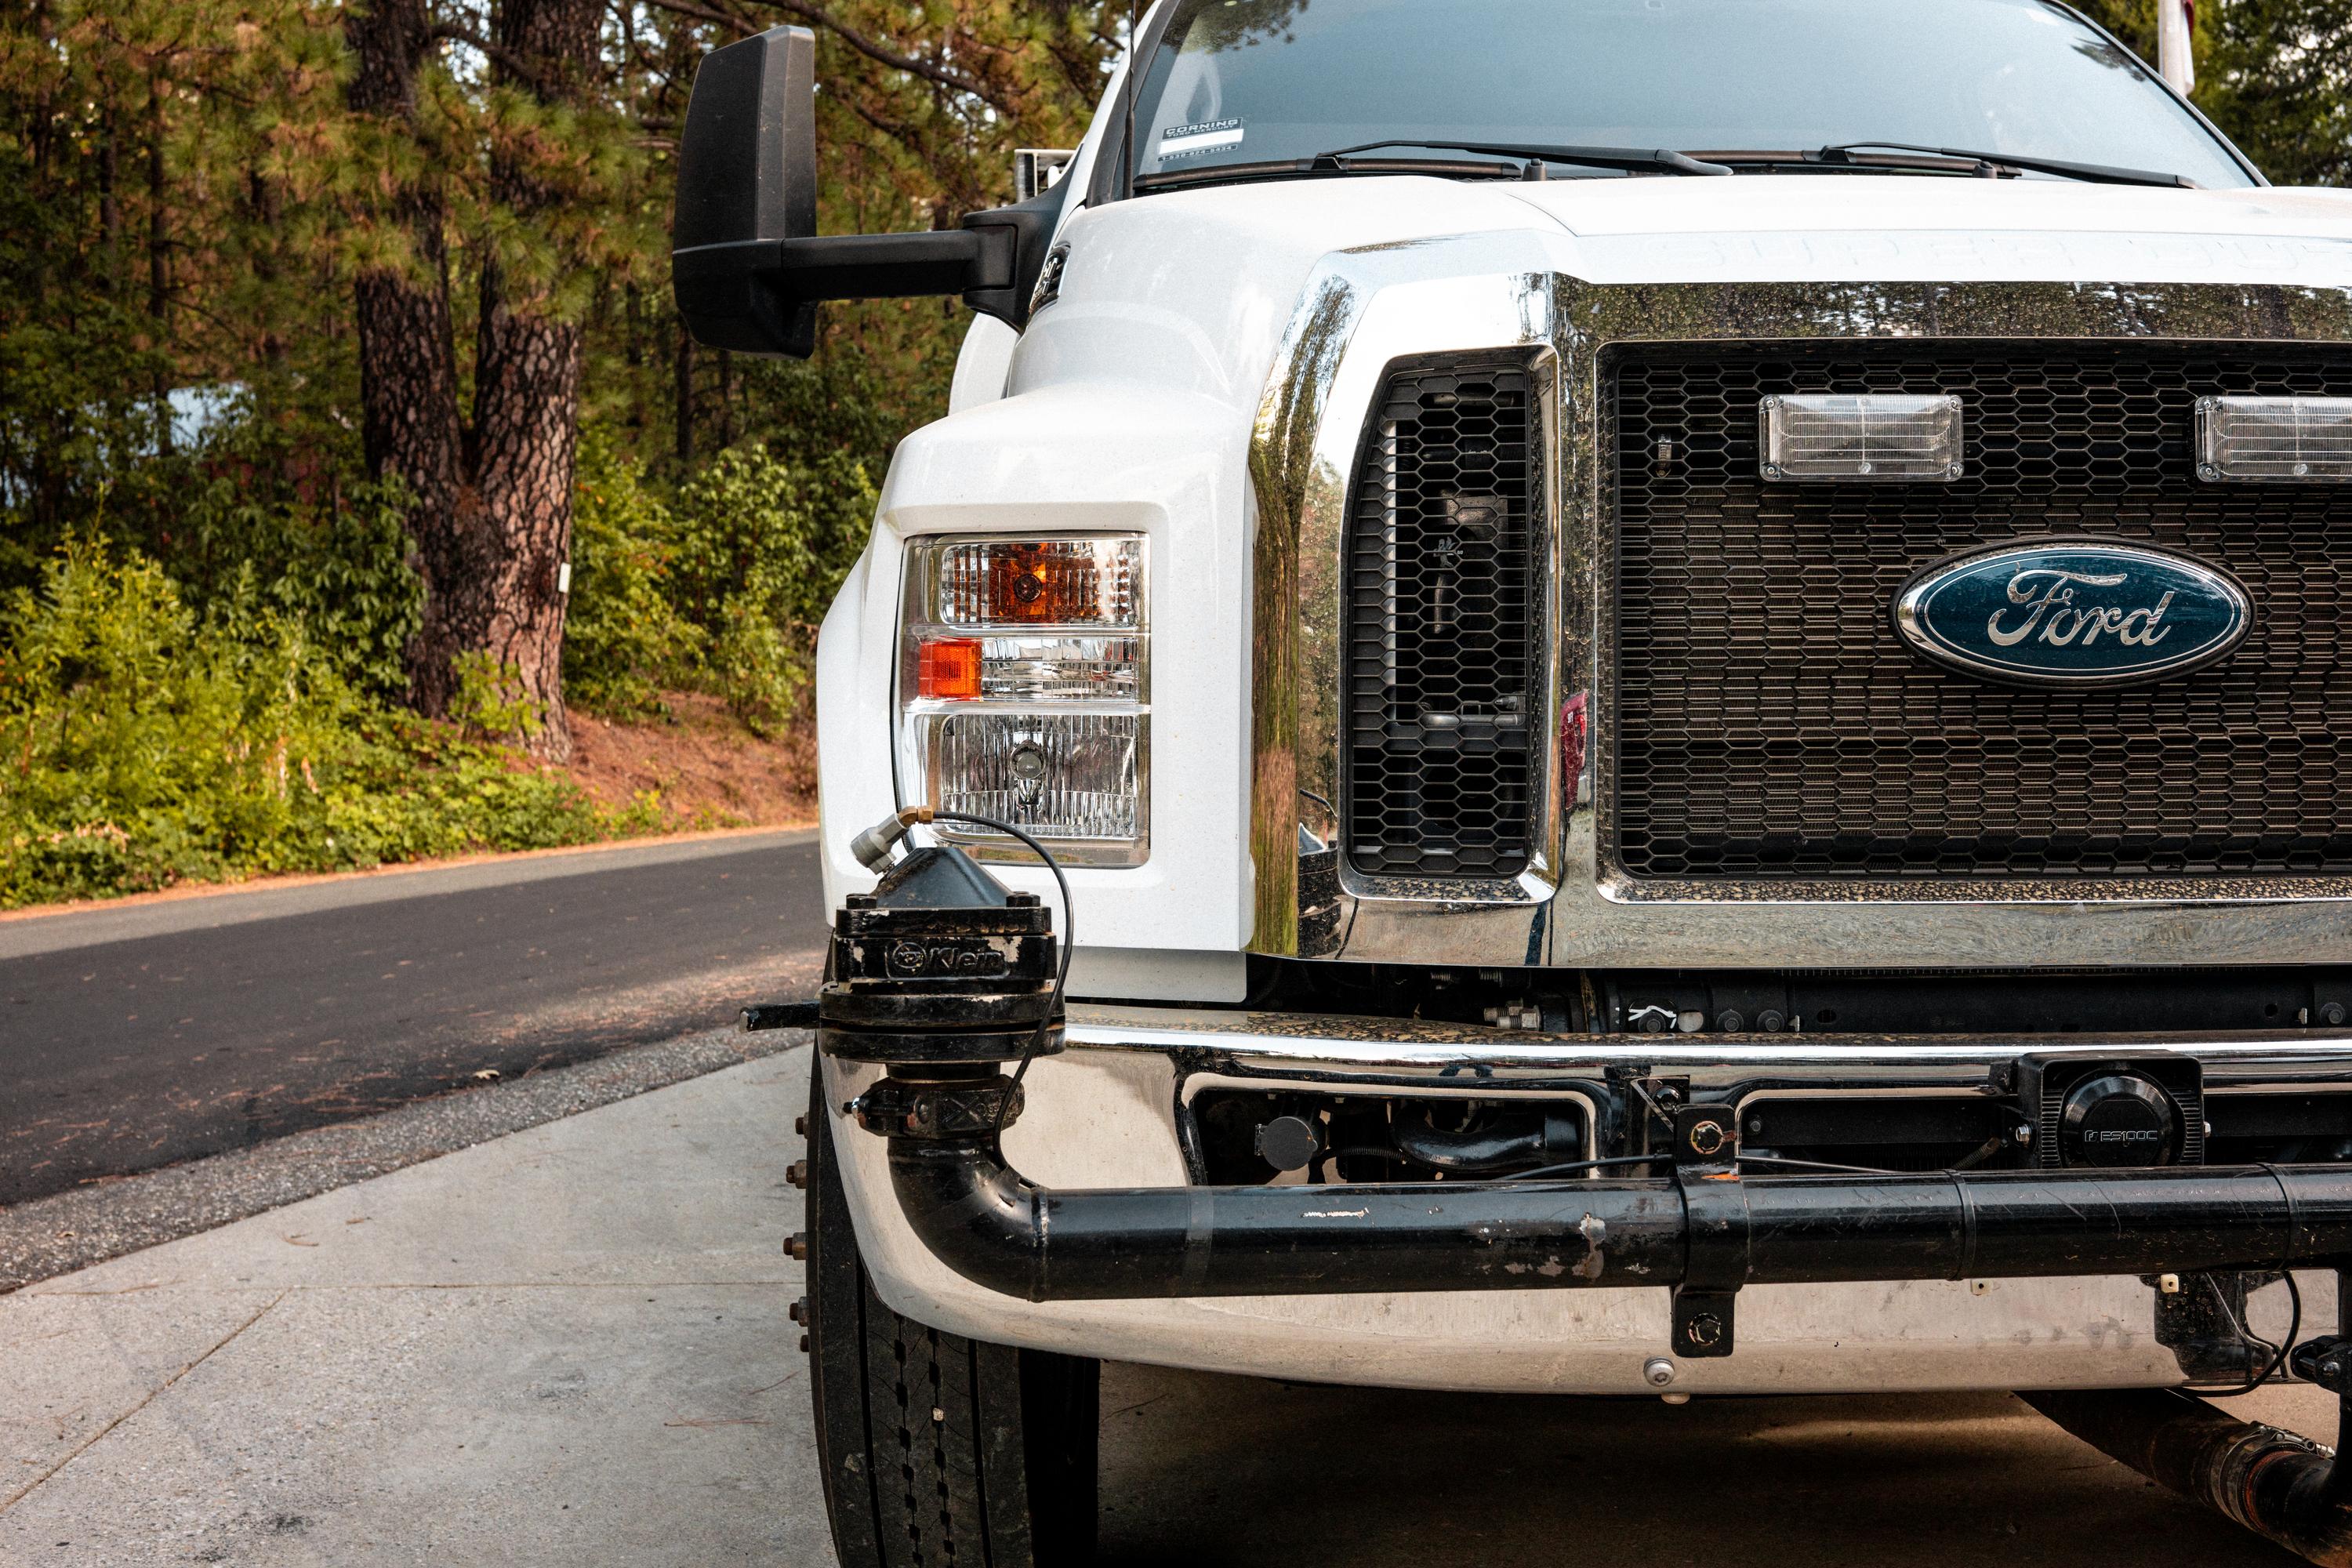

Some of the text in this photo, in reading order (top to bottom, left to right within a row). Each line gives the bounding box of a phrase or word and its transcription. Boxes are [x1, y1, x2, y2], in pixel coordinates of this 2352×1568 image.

[1166, 119, 1238, 135] CORNING
[1988, 570, 2174, 645] Ford
[929, 947, 1004, 969] Klein
[2100, 1131, 2158, 1141] ES100C
